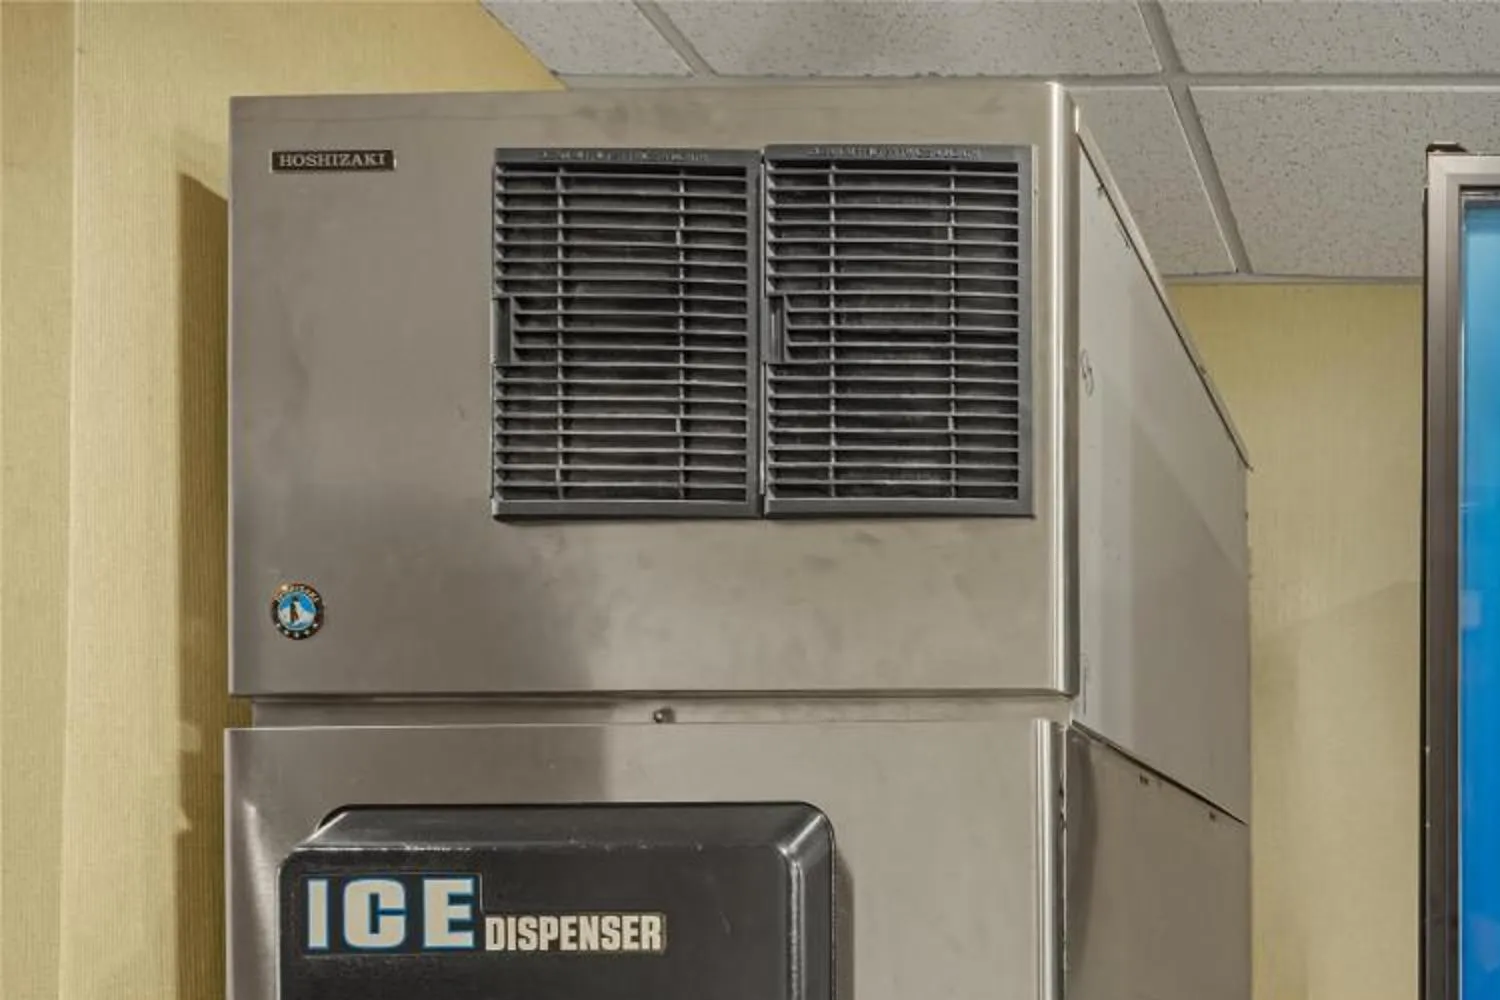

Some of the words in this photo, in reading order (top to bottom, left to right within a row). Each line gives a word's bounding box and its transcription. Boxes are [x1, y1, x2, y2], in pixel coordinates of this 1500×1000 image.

[280, 153, 385, 166] HOSHIZAKI
[307, 878, 476, 949] ICE
[486, 914, 663, 952] DISPENSER
